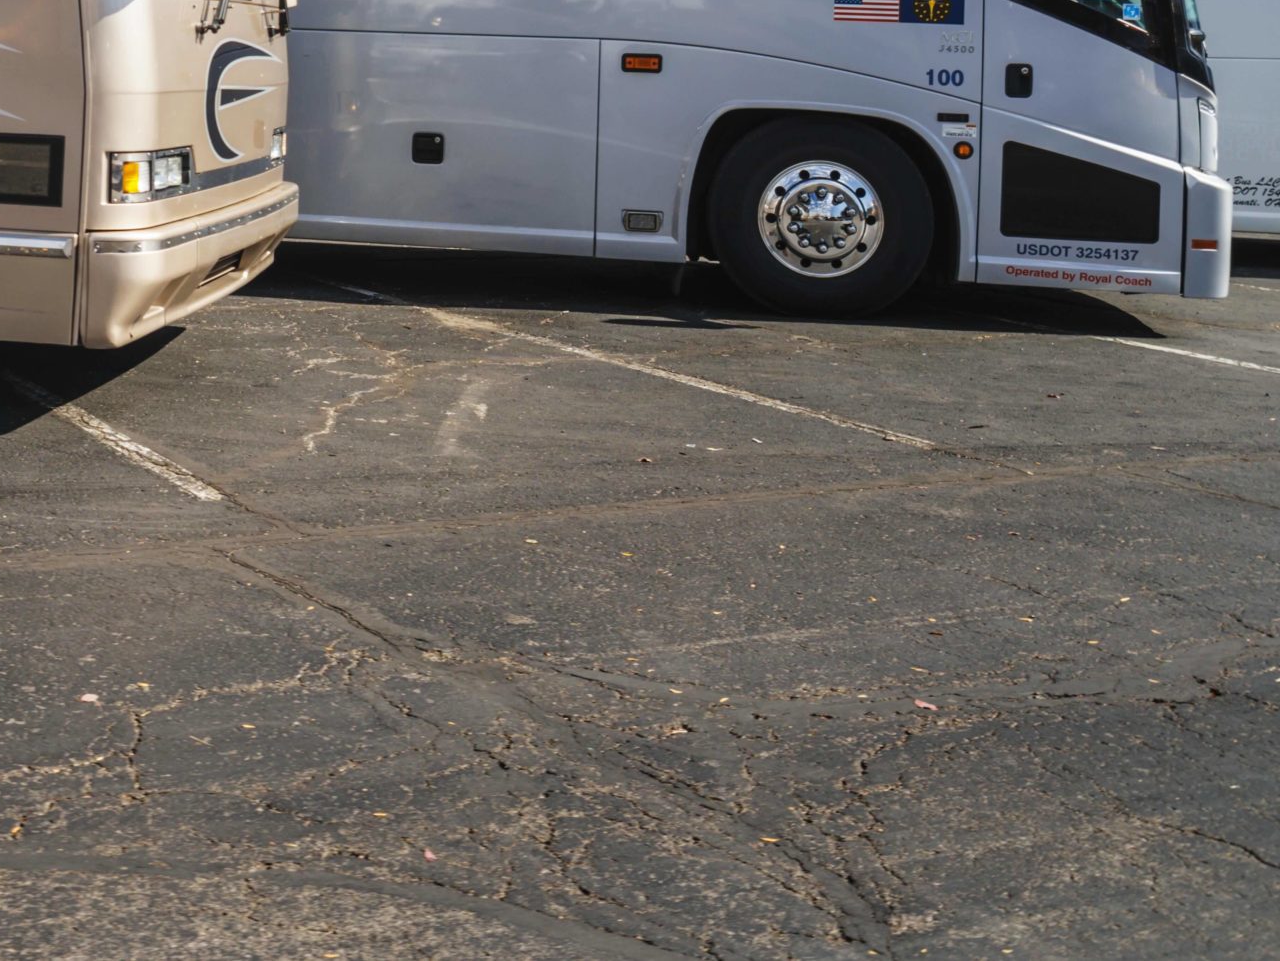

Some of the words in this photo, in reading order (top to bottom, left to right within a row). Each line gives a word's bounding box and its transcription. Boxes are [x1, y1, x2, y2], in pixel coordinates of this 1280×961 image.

[926, 68, 964, 87] 100
[1233, 175, 1252, 186] Bus
[1016, 243, 1072, 257] USDOT
[1076, 246, 1139, 261] 3254137
[1005, 265, 1059, 279] Operated
[1062, 269, 1076, 283] by
[1079, 272, 1112, 284] Royal
[1115, 275, 1152, 287] Coach
